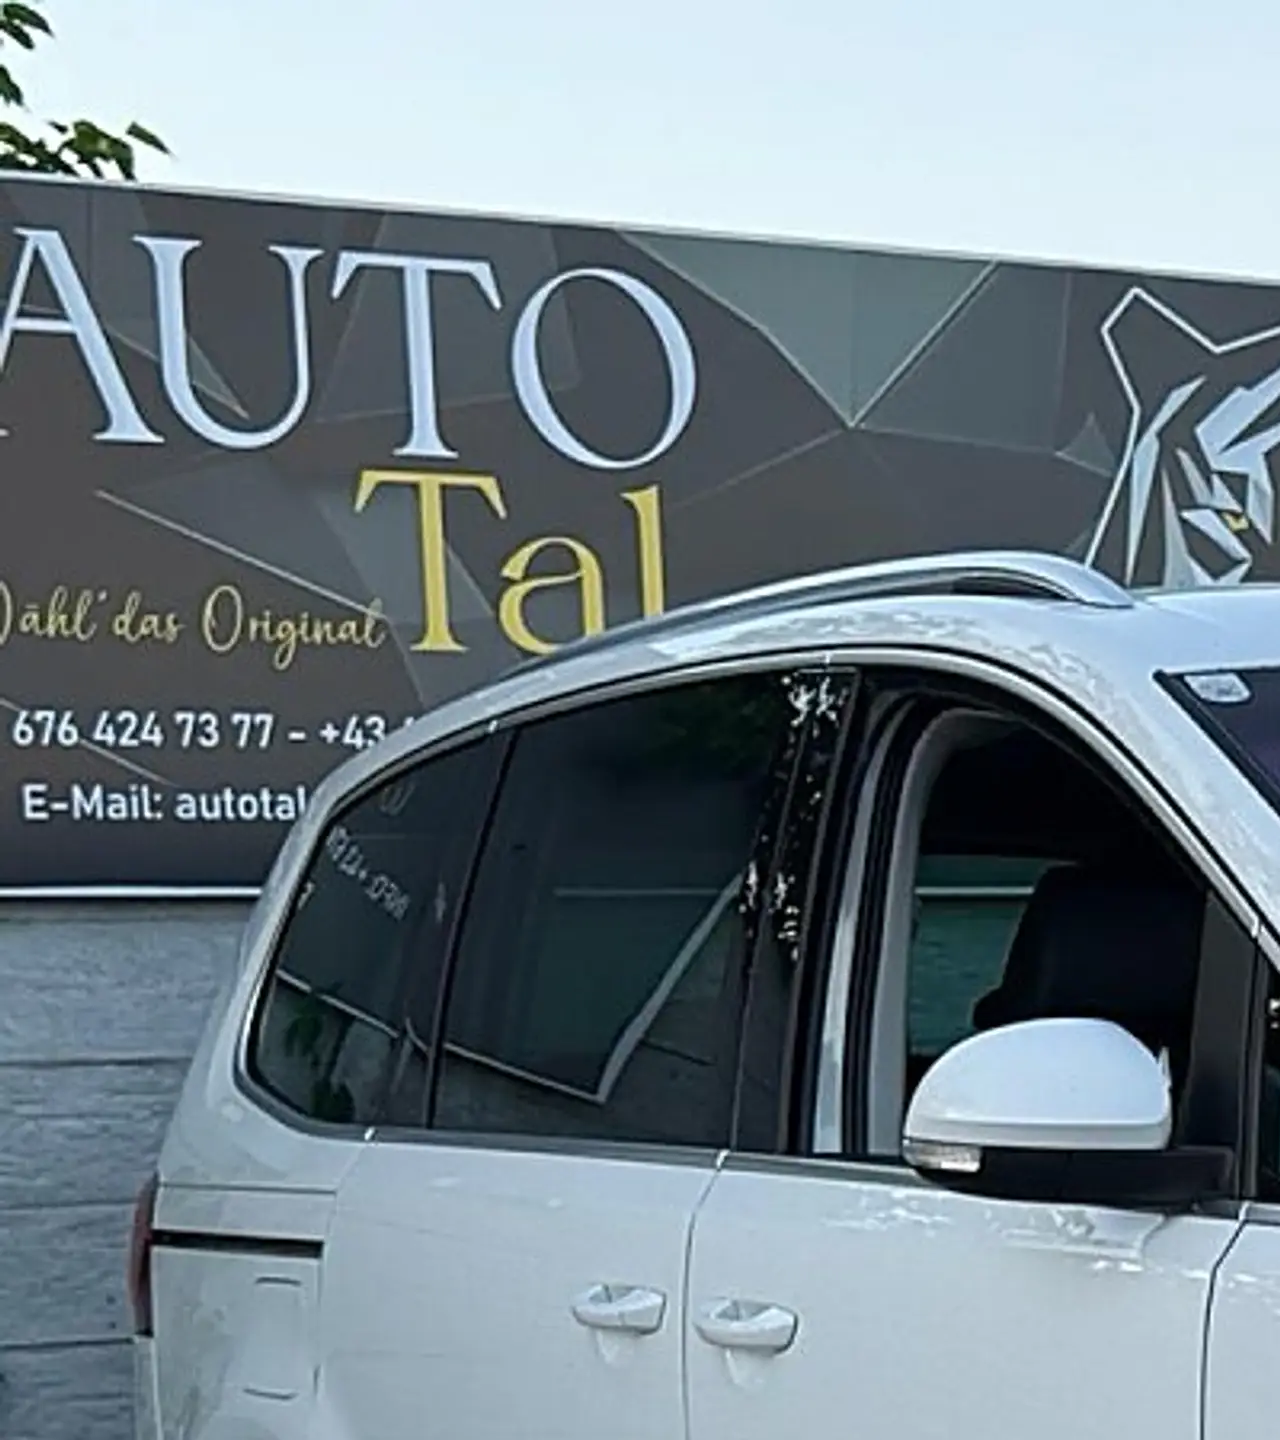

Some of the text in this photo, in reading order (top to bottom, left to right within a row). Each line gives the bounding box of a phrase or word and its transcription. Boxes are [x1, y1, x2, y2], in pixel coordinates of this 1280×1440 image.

[0, 226, 697, 470] AUTO
[354, 469, 665, 655] Tal
[112, 589, 187, 643] das
[203, 585, 386, 670] Original
[12, 710, 80, 748] 676
[93, 710, 164, 748] 424
[175, 711, 220, 748] 73
[231, 712, 274, 749] 77
[319, 714, 387, 749] +43
[22, 783, 306, 822] E-Mail: autotal
